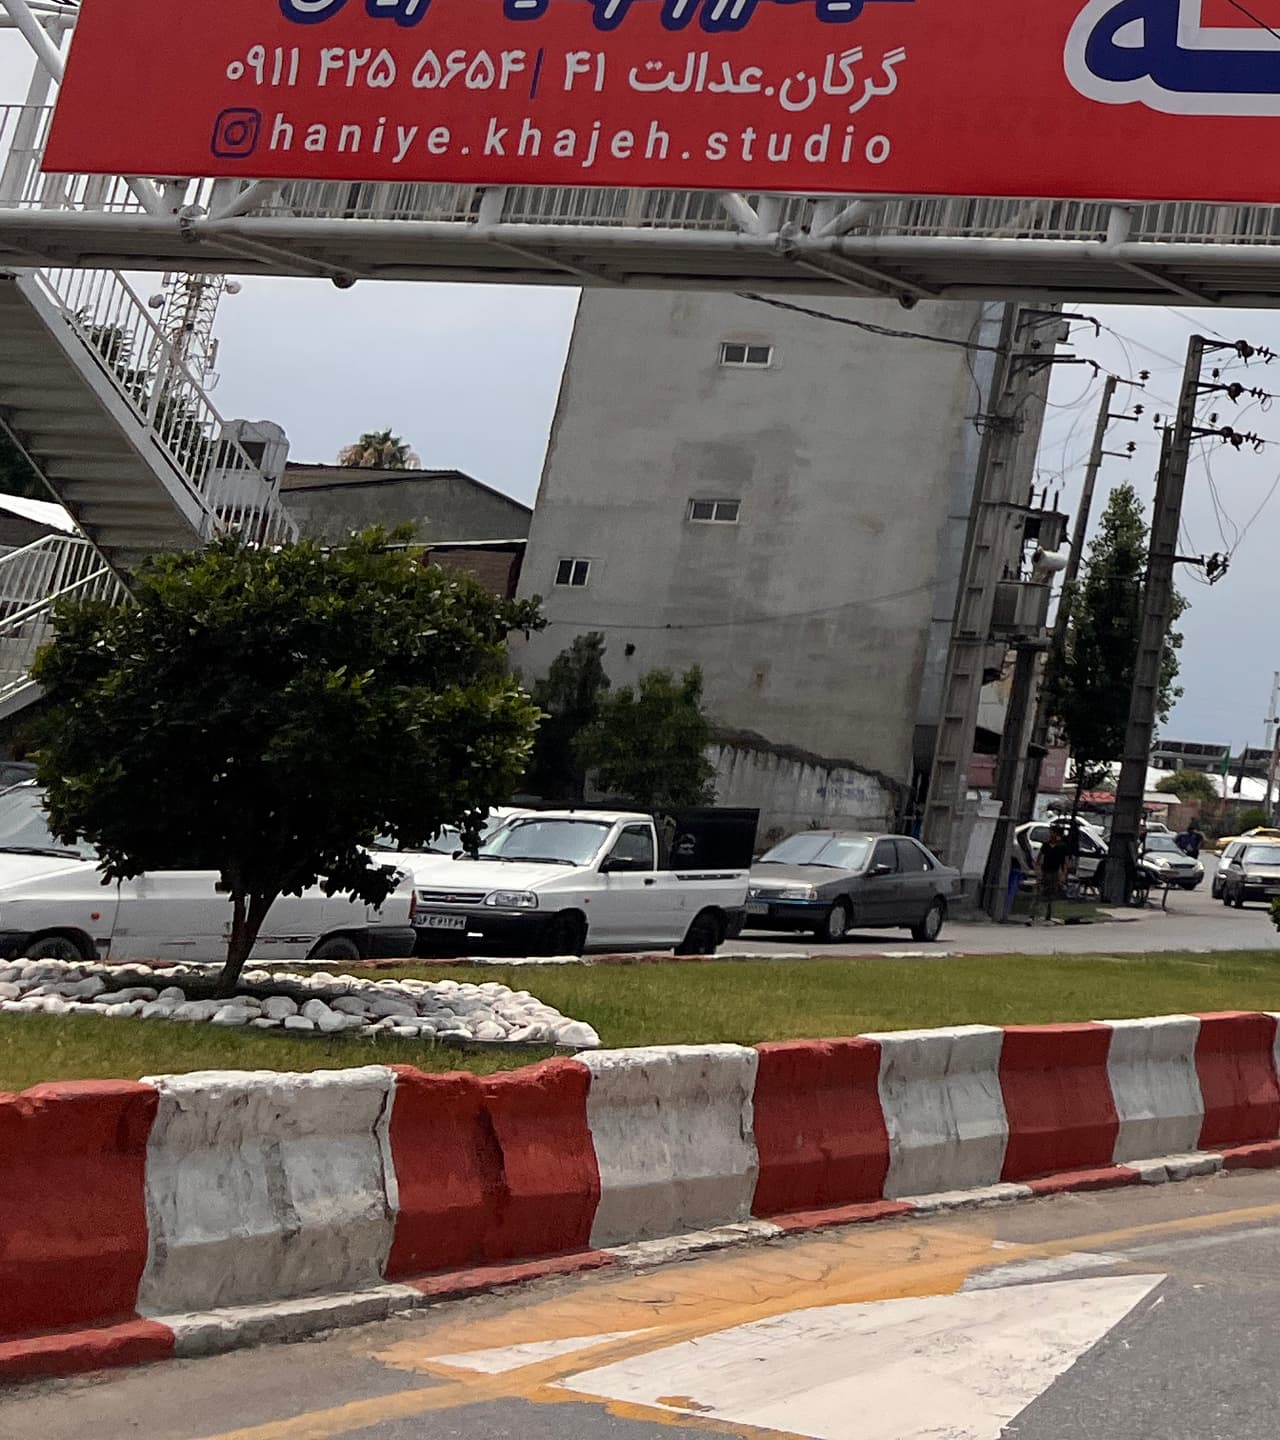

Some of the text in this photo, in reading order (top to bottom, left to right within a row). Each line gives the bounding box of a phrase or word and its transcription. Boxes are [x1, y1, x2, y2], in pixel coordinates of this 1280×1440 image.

[226, 44, 299, 86] ۰۹۱۱
[317, 47, 396, 88] ۴۲۵
[411, 49, 526, 90] ۵۶۵۴
[563, 50, 606, 92] ۴۱
[269, 112, 891, 168] haniye.khajeh.studio
